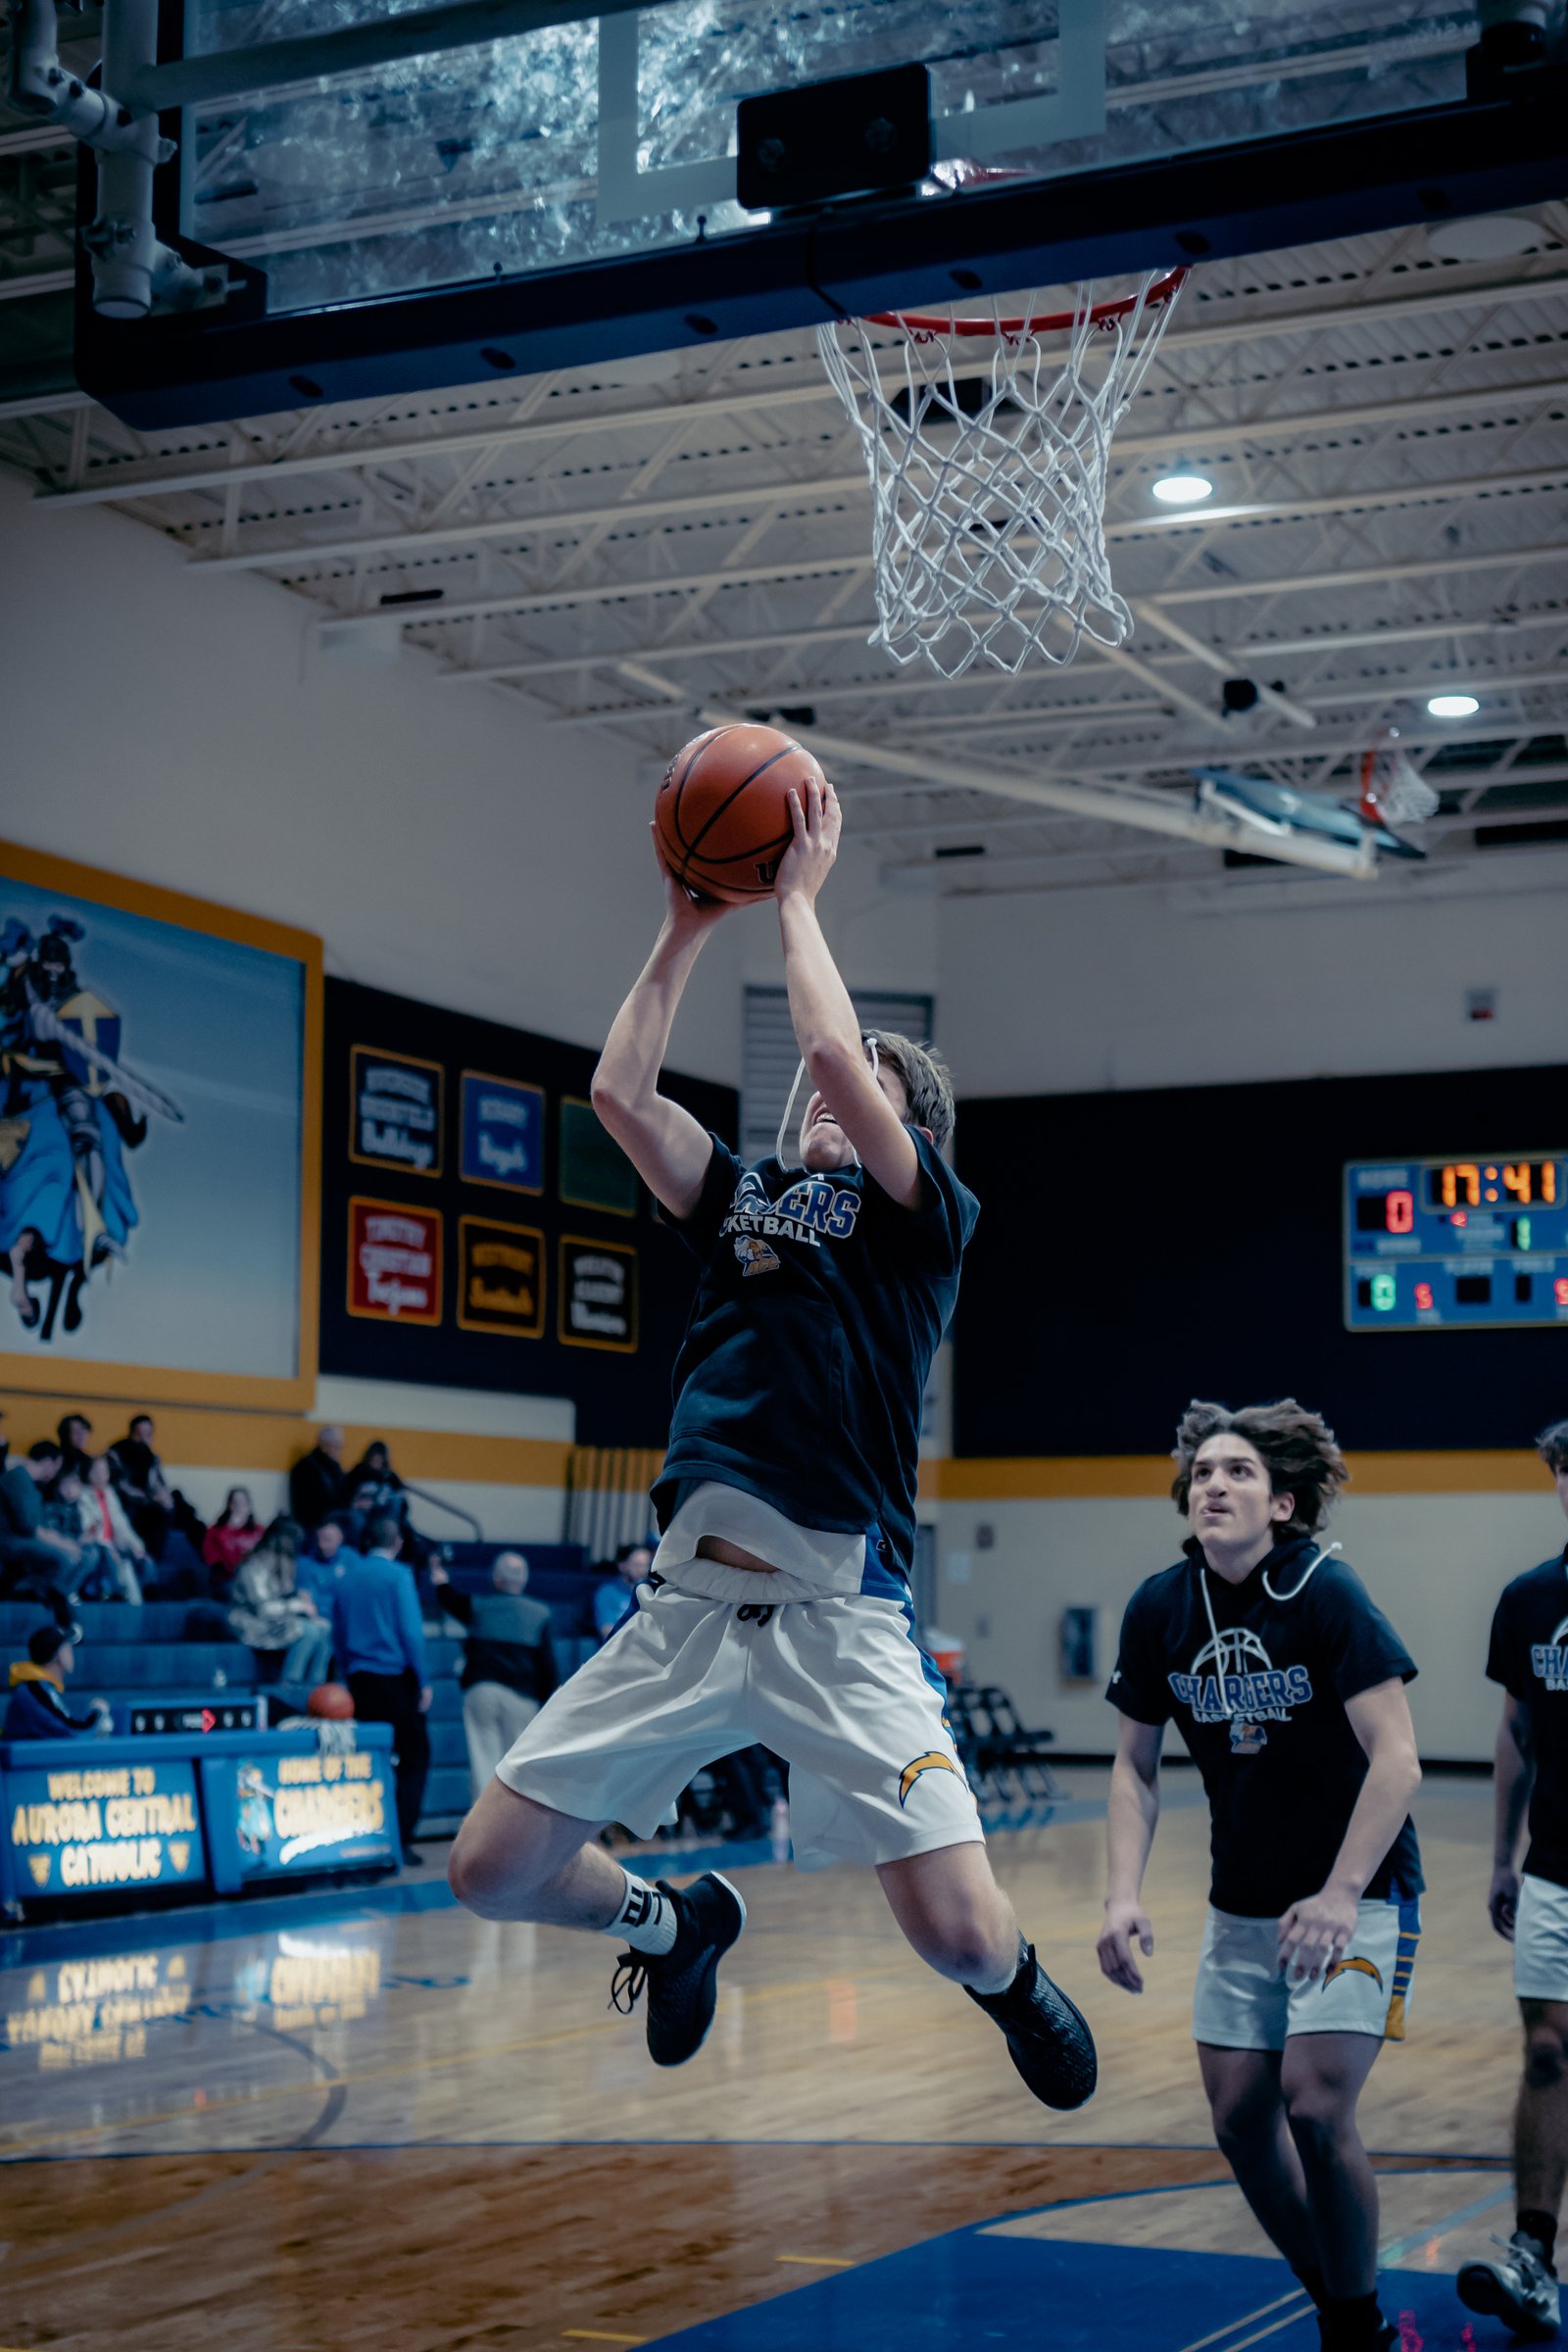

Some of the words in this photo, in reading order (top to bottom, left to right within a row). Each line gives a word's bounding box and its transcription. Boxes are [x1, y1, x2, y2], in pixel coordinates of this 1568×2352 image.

[1442, 1160, 1555, 1207] 17:41
[719, 1214, 821, 1248] KETBALL
[1386, 1191, 1413, 1233] 0
[1192, 1707, 1293, 1724] BASETBALL
[48, 1768, 130, 1800] WELCOME
[132, 1766, 155, 1794] TO
[12, 1799, 102, 1845] AURORA
[106, 1792, 196, 1837] CENTRAL
[61, 1838, 162, 1886] CATHOLIC
